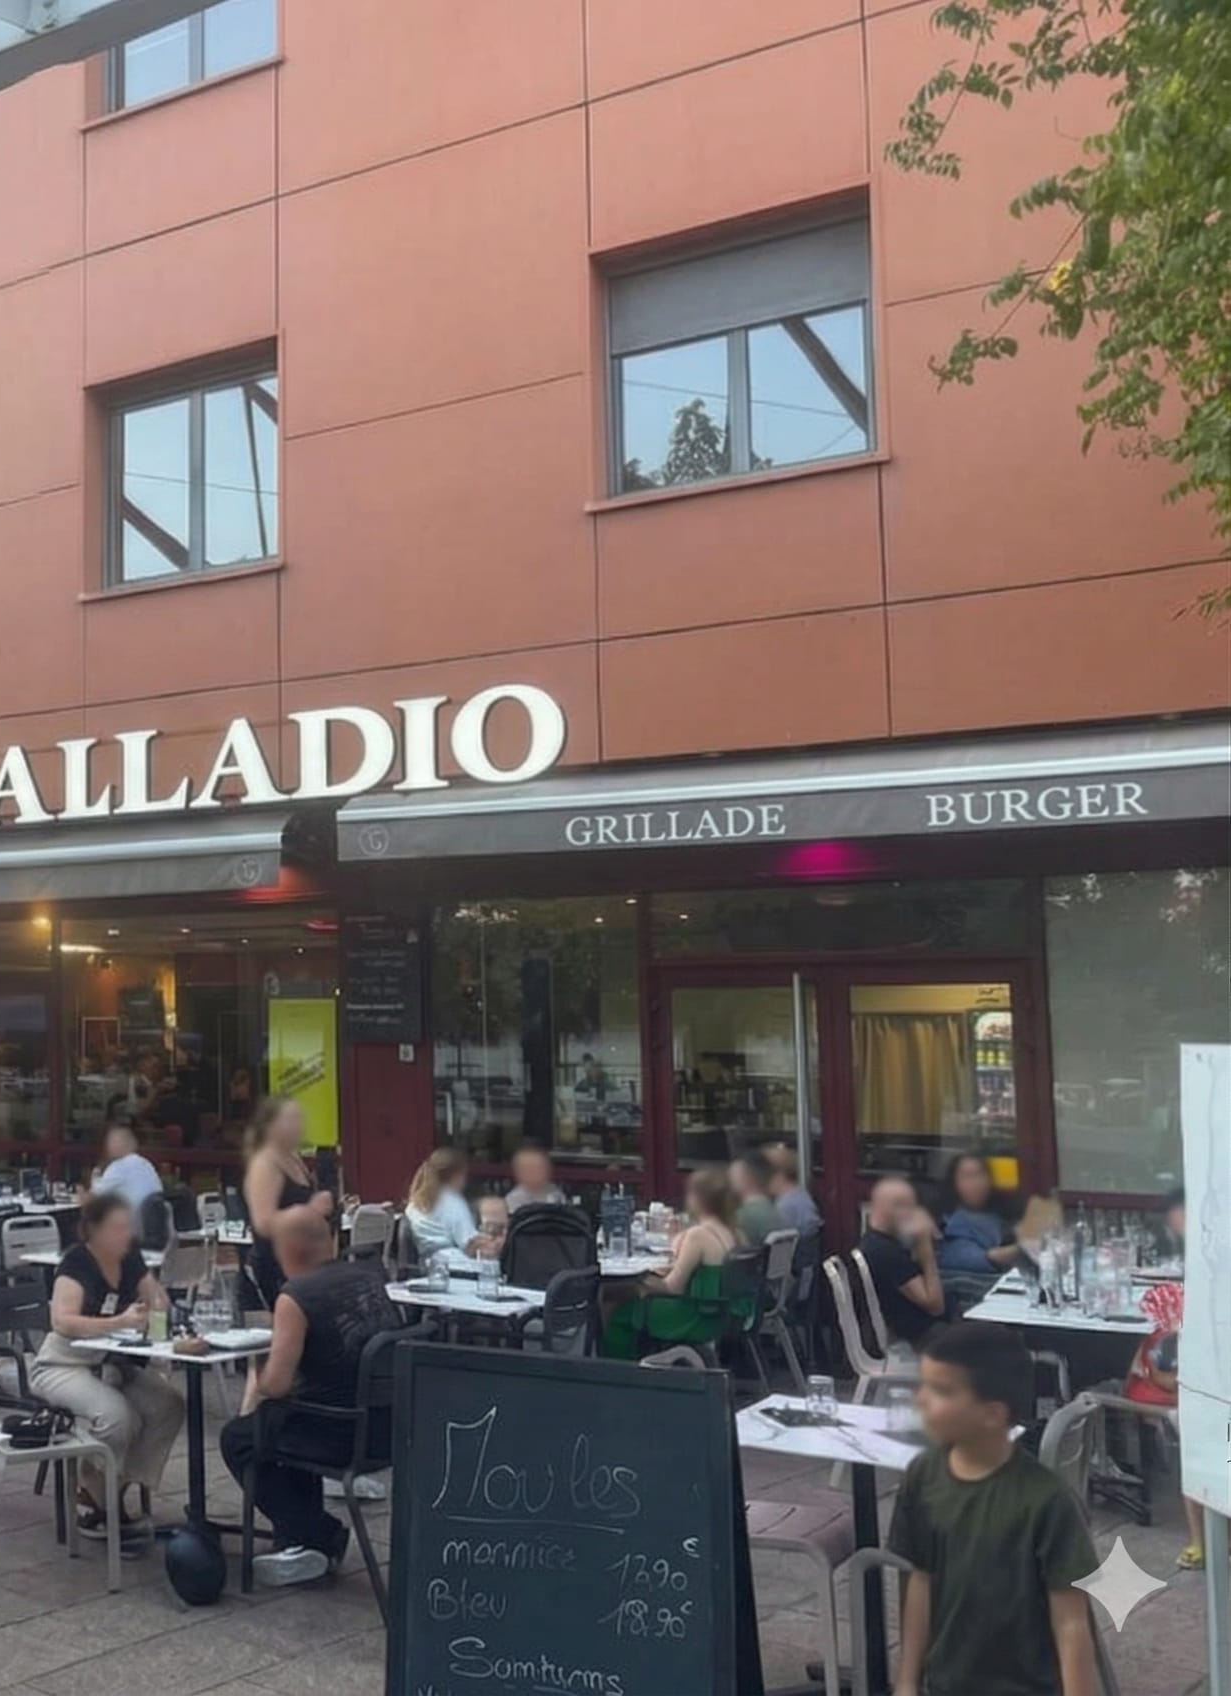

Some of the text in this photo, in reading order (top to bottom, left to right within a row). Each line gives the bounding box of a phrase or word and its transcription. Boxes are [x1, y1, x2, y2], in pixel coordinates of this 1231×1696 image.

[565, 804, 787, 848] GRILLADE
[925, 782, 1149, 827] BURGER
[432, 1406, 642, 1518] Moules
